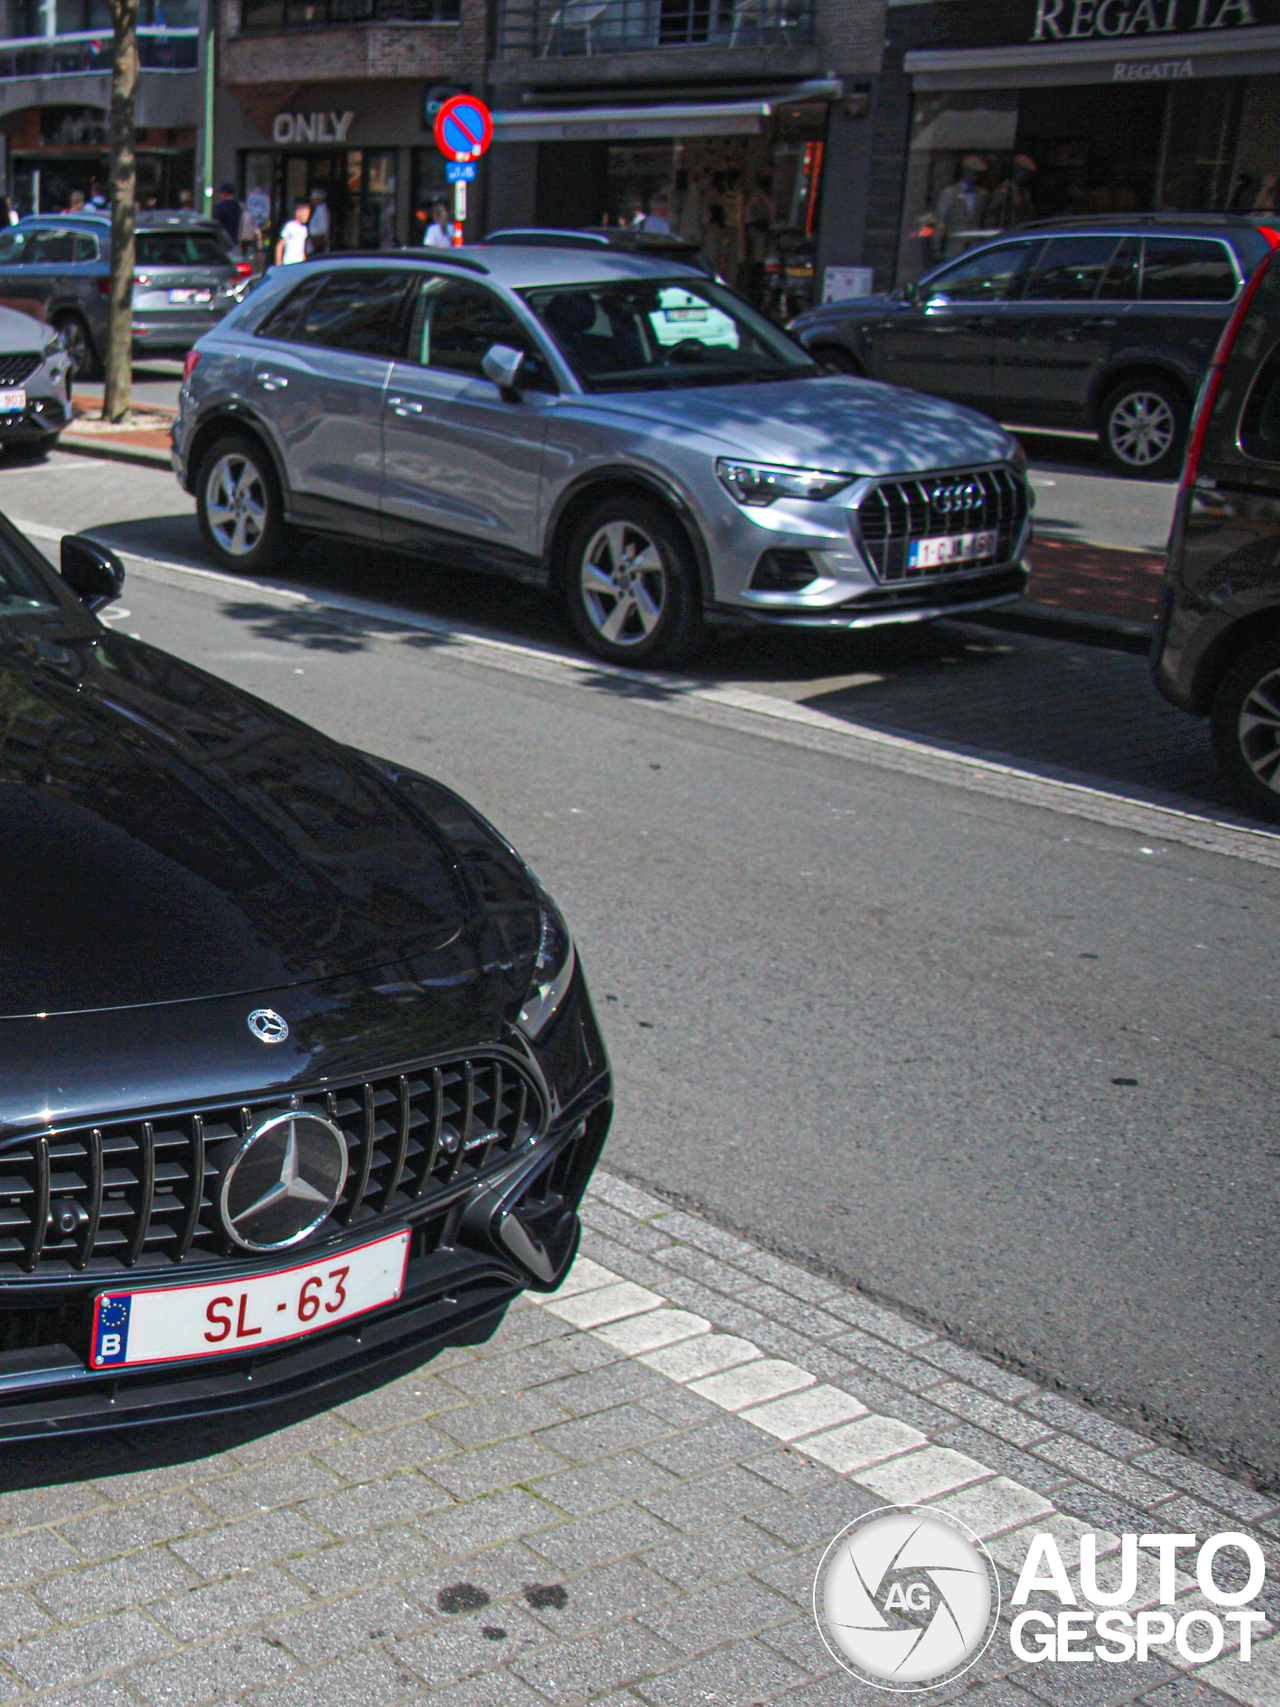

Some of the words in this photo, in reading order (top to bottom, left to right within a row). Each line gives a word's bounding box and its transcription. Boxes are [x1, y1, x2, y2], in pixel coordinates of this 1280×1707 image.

[1111, 59, 1195, 81] REGATTA
[274, 111, 355, 143] ONLY
[101, 1333, 121, 1357] B
